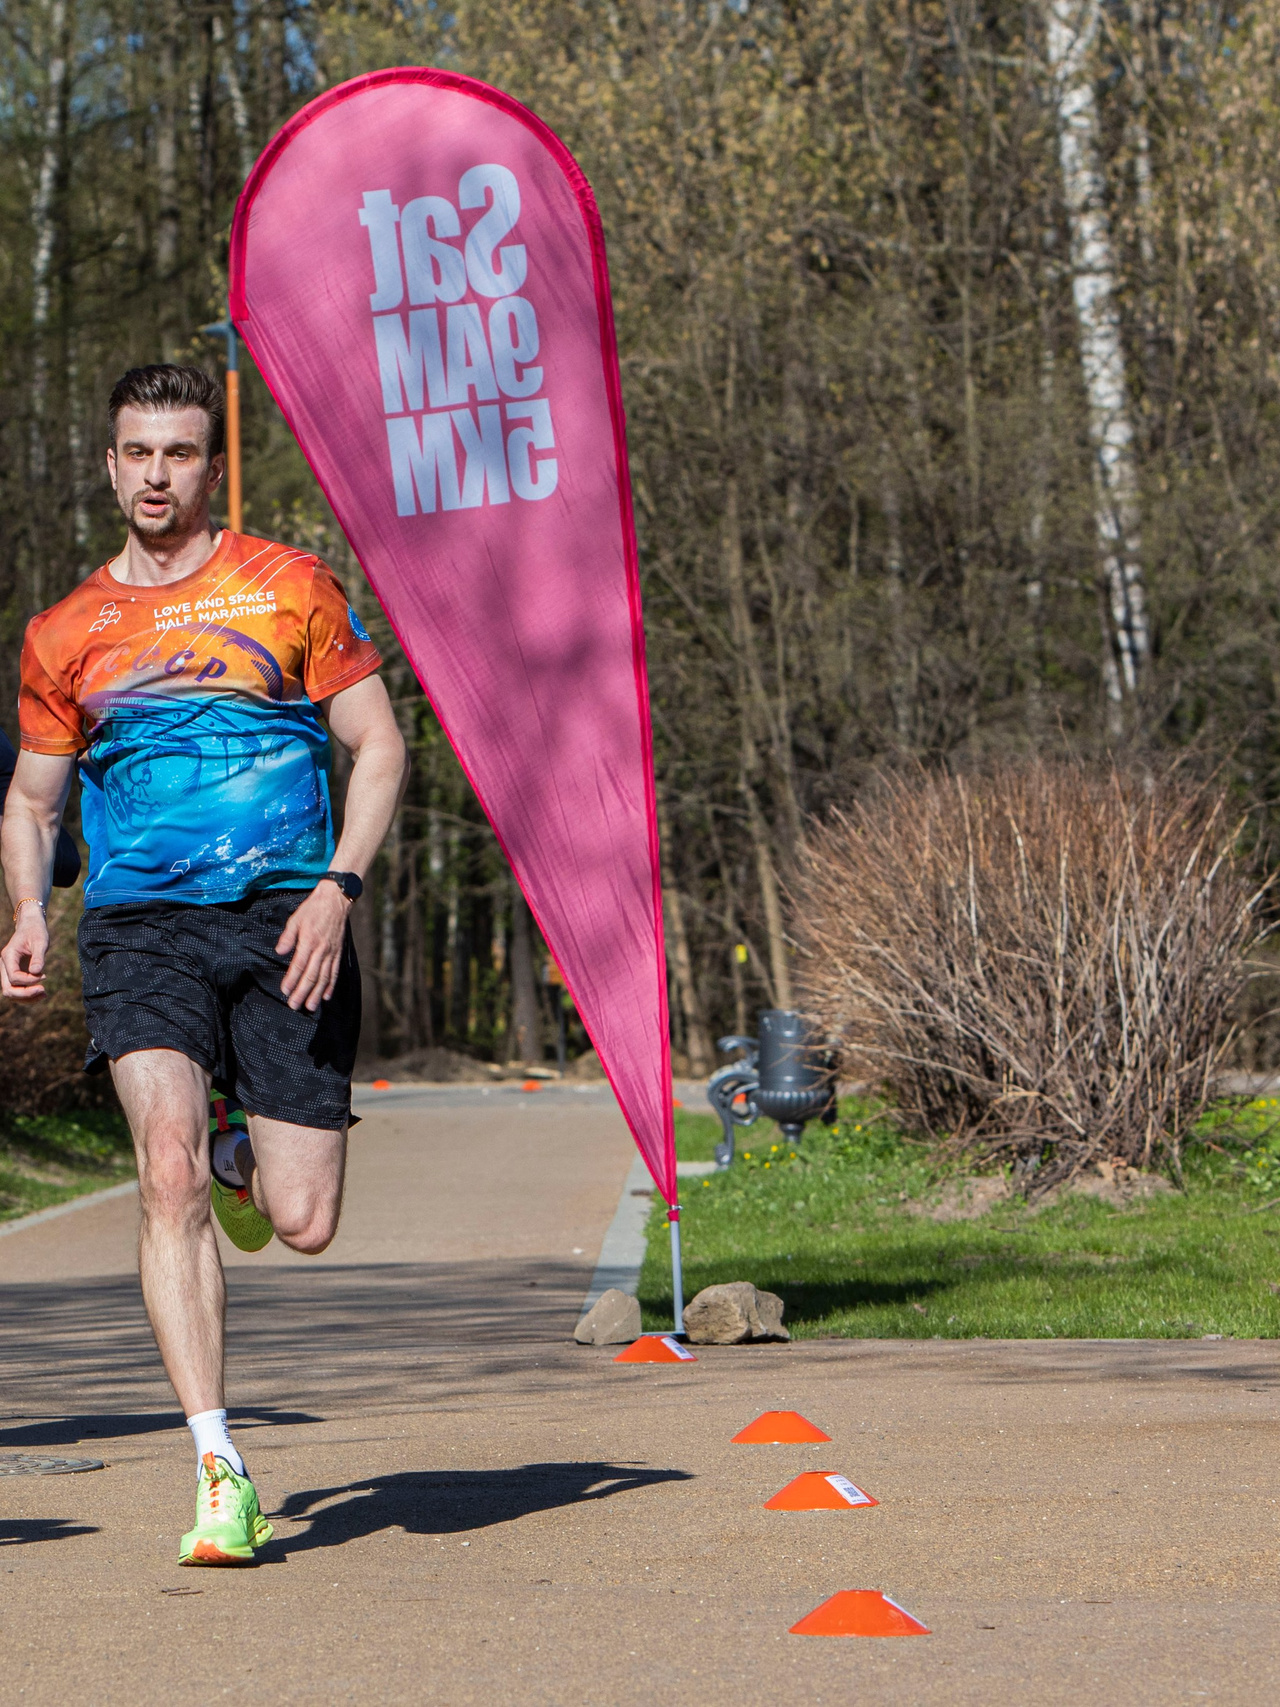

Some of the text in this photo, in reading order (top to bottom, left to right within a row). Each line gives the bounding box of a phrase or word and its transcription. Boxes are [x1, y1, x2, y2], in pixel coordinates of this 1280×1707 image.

[194, 597, 225, 611] AND
[228, 591, 275, 605] SPACE
[155, 615, 192, 631] HALF
